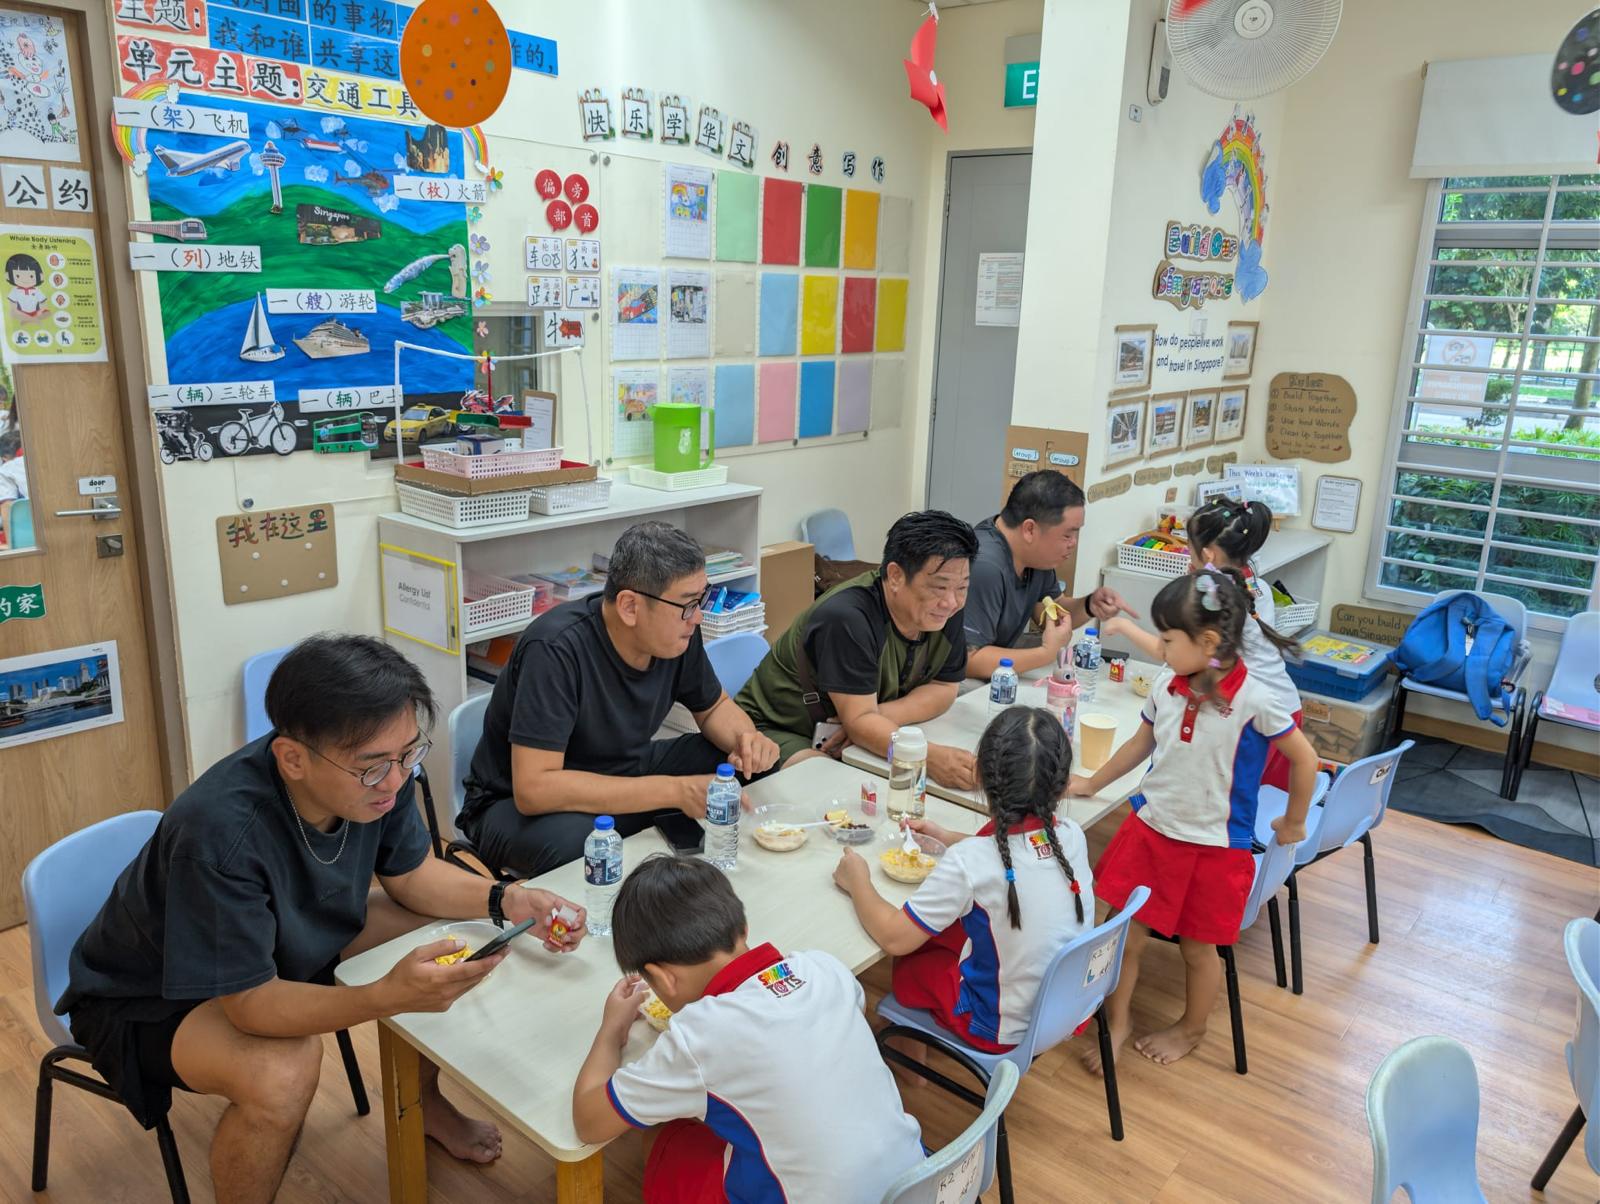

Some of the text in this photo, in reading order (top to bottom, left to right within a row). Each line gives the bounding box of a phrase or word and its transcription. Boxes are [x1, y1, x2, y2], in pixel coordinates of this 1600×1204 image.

[8, 175, 88, 210] 公约
[1154, 334, 1169, 347] How
[1170, 333, 1179, 346] do
[1211, 336, 1224, 348] work
[1156, 355, 1169, 367] and
[1194, 356, 1224, 372] Singapore?
[1289, 375, 1324, 387] Rules
[89, 479, 106, 487] door
[398, 581, 419, 597] Allergy
[1337, 608, 1402, 630] Can you build
